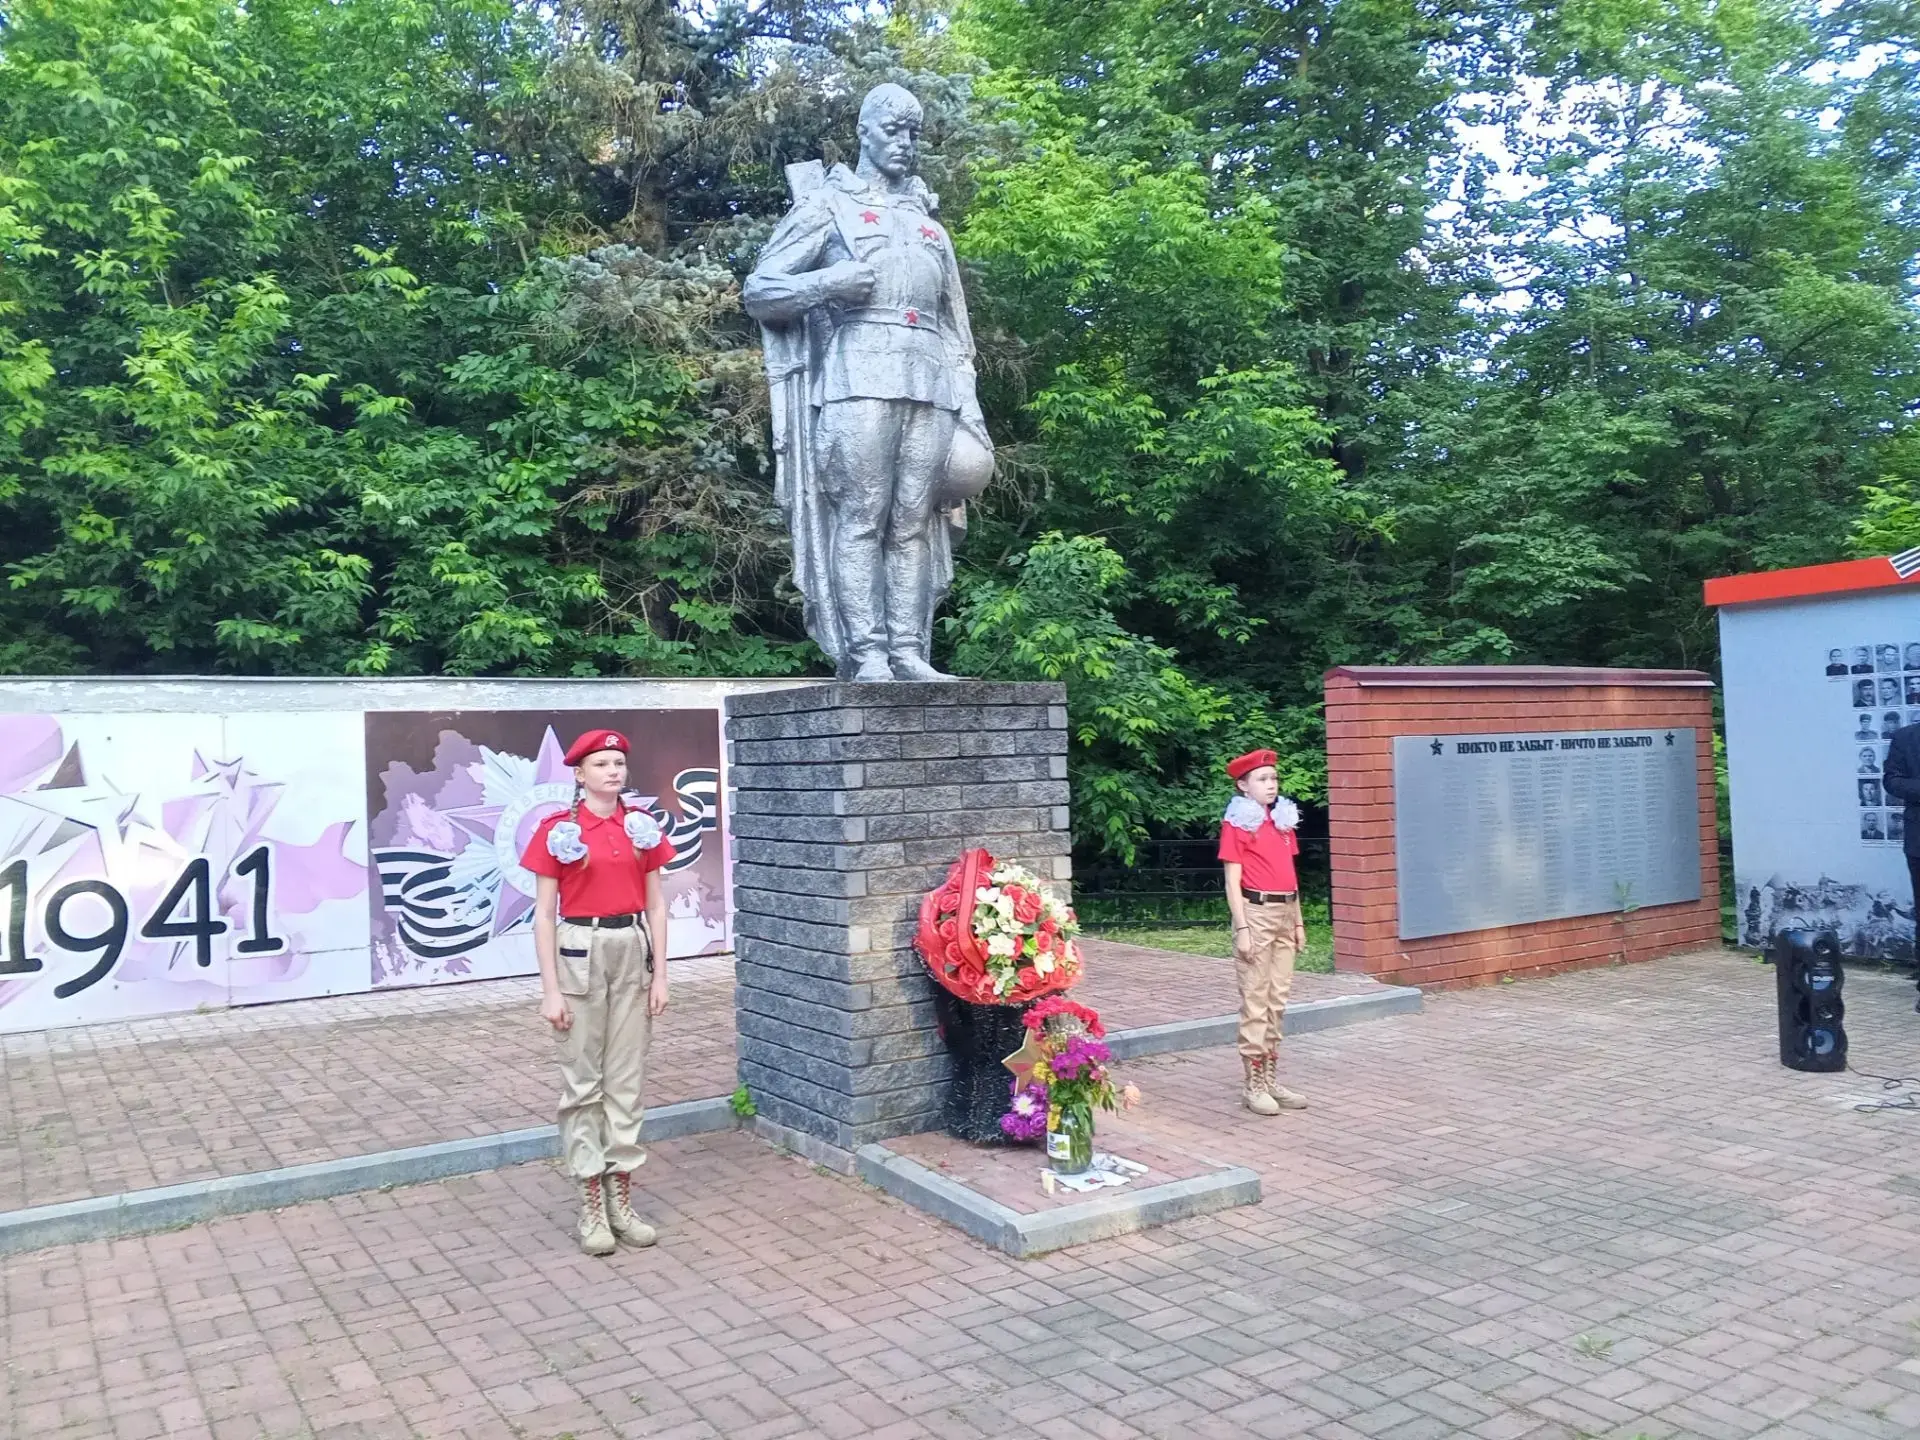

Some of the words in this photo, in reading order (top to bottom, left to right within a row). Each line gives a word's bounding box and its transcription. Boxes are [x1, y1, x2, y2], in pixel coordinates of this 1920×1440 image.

[1456, 741, 1497, 754] НИКТО
[1499, 740, 1515, 753] НЕ
[1517, 739, 1554, 751] ЗАБЫТ
[1560, 737, 1596, 750] НИЧТО
[1597, 737, 1611, 749] НЕ
[1613, 735, 1653, 748] ЗАБЫТО
[0, 846, 284, 999] 1941
